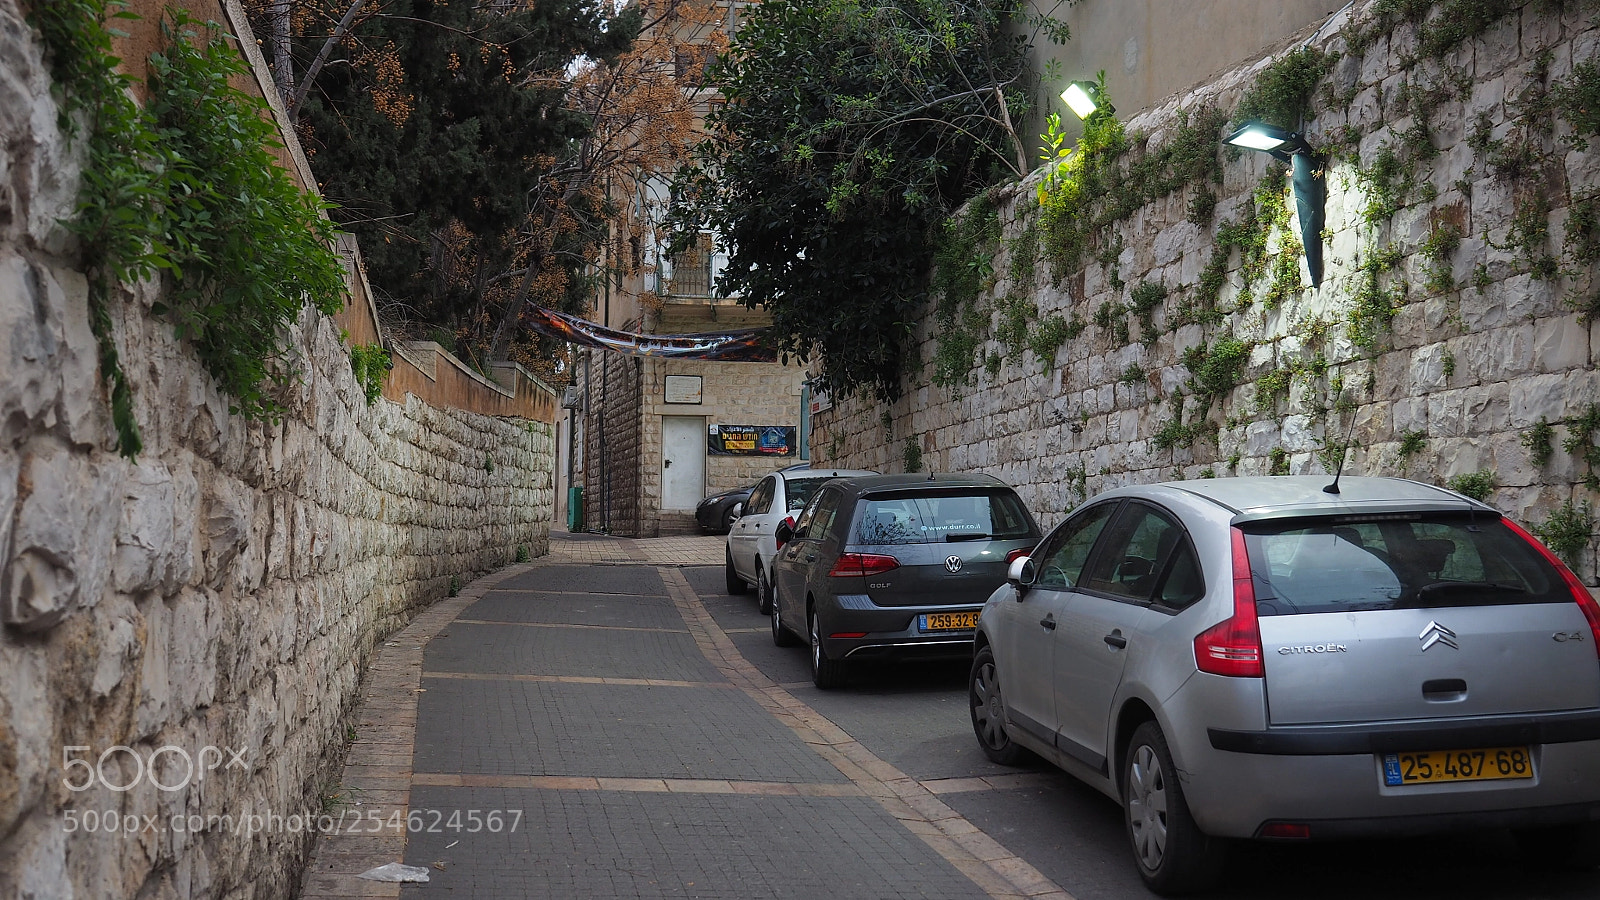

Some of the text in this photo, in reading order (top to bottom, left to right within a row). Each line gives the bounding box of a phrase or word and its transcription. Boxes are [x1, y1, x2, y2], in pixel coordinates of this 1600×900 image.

[742, 432, 758, 441] חודש
[869, 582, 892, 590] GOLF
[1552, 630, 1585, 643] C4
[1277, 643, 1347, 656] CITROËN
